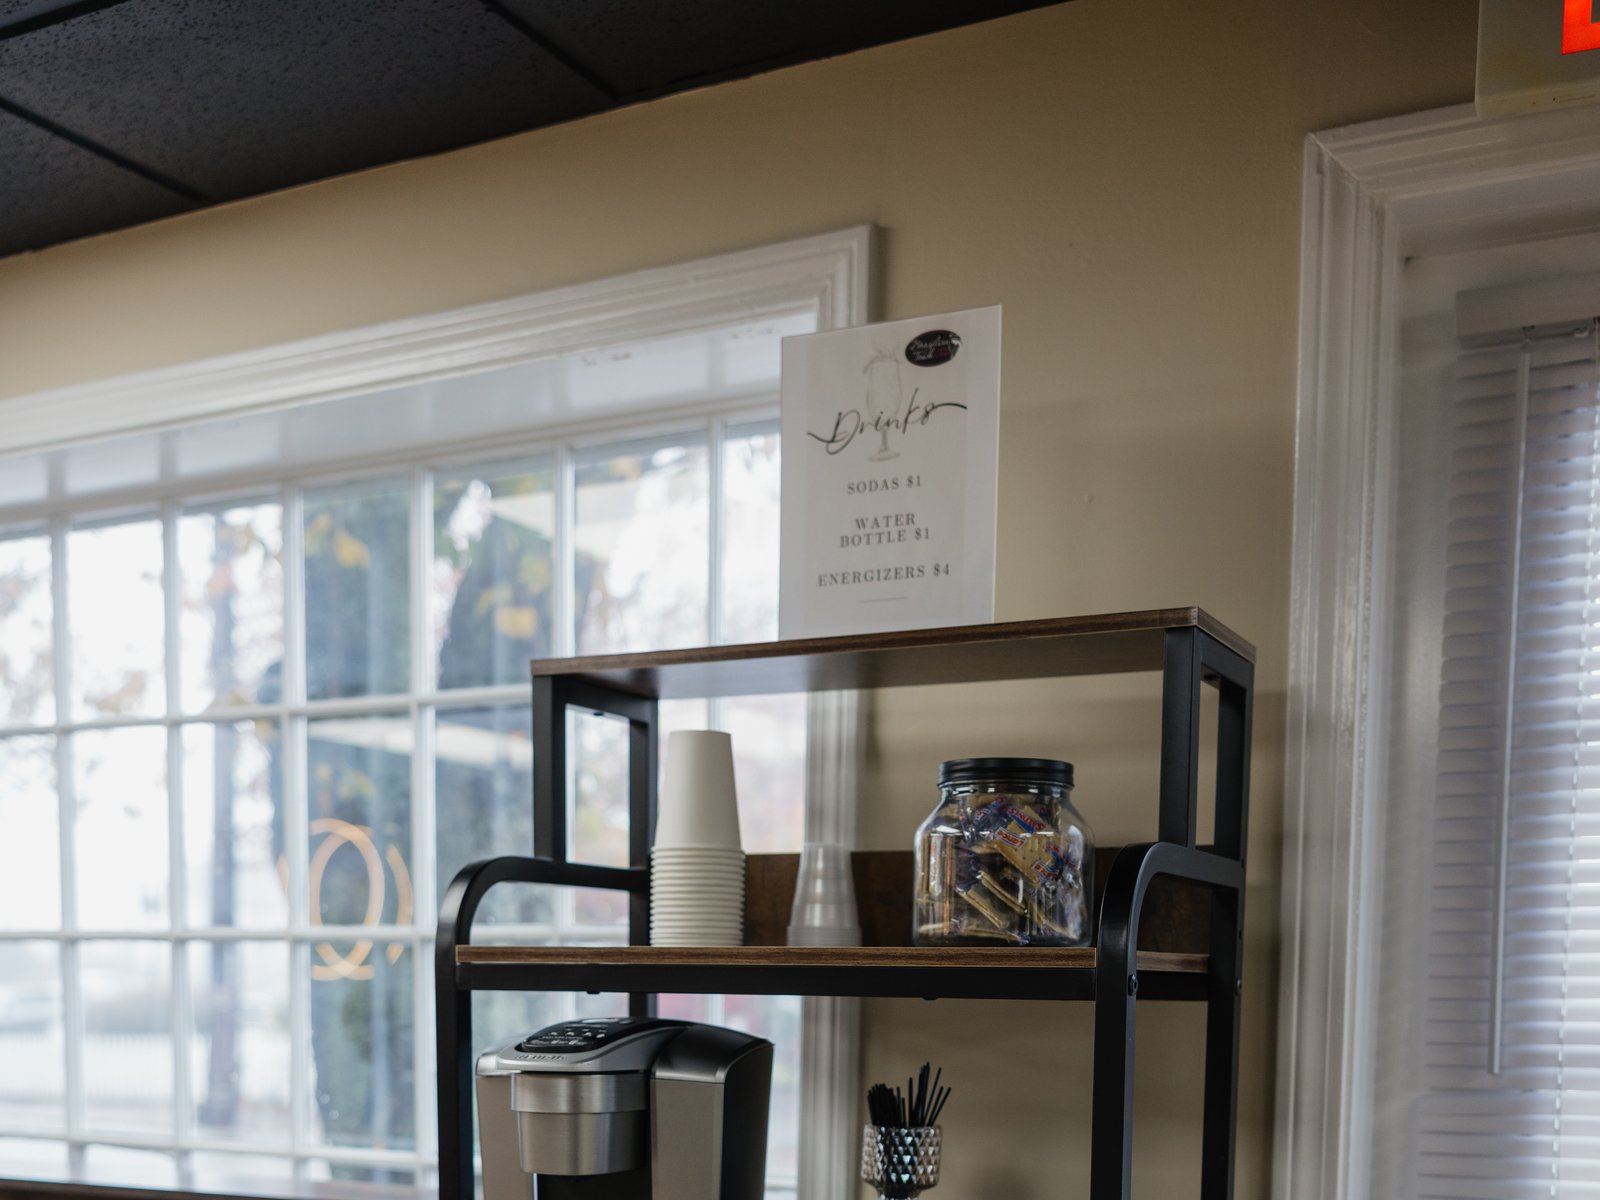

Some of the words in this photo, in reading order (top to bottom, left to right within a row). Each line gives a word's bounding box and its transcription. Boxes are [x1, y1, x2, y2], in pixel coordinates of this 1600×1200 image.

[807, 387, 968, 455] Drinks
[847, 477, 900, 495] SODAS
[907, 475, 922, 488] $1
[855, 512, 916, 530] WATER
[840, 530, 907, 548] BOTTLE
[915, 527, 930, 541] $1
[818, 564, 926, 587] ENERGIZERS
[933, 563, 950, 576] $4
[997, 830, 1026, 847] Lance
